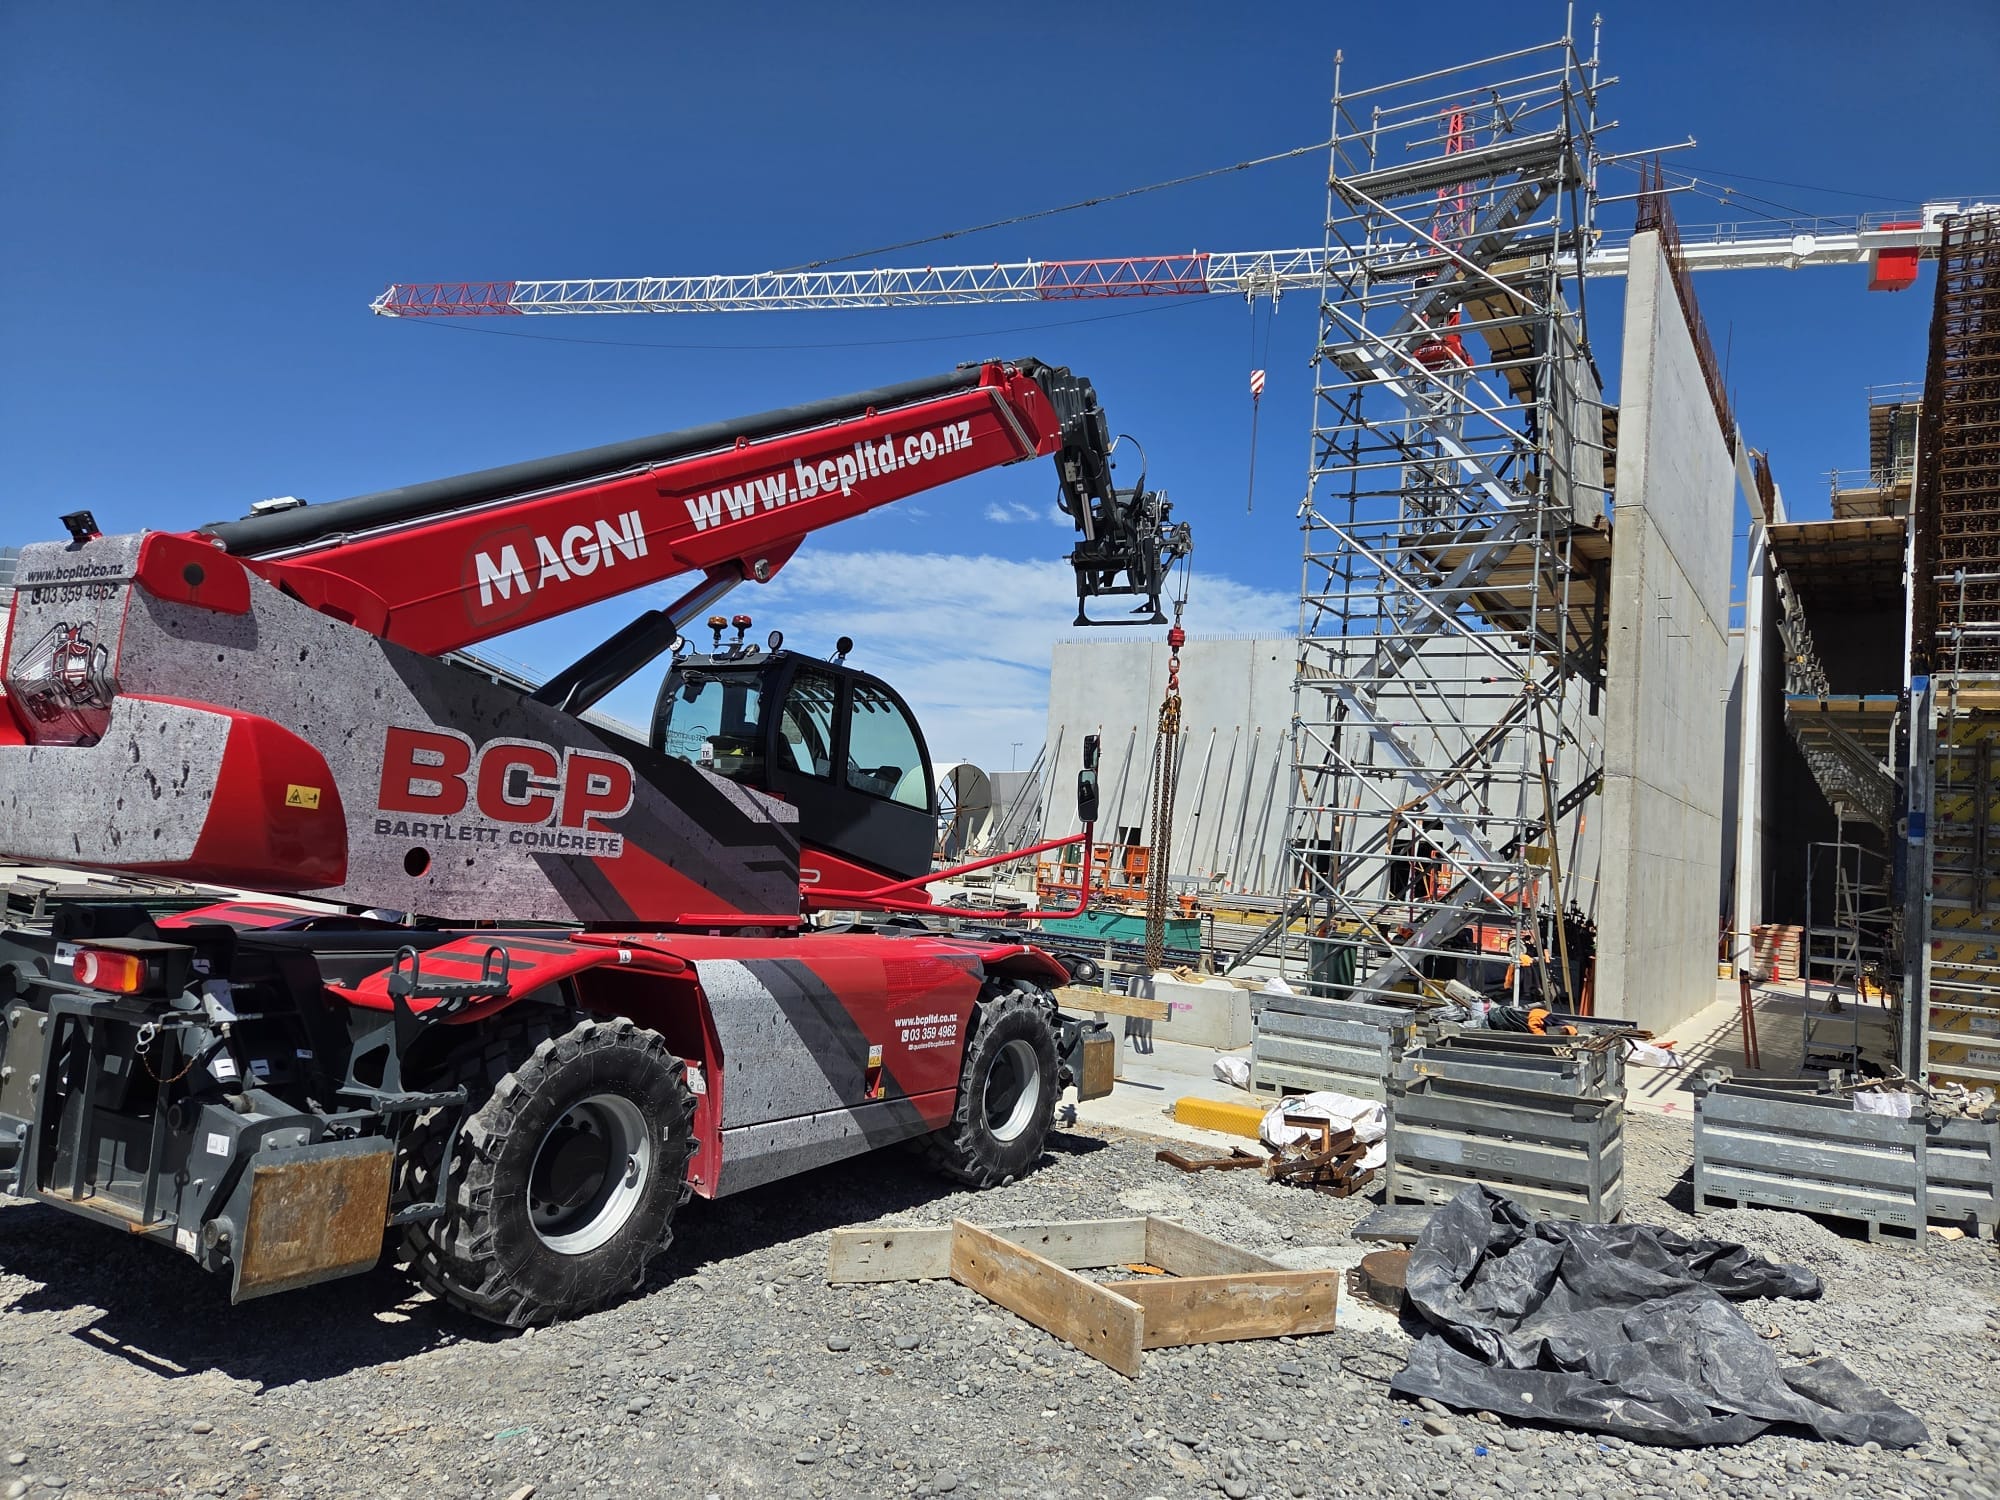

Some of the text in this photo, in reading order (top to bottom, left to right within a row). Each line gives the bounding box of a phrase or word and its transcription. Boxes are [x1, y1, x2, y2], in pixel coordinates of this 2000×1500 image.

[684, 420, 973, 531] www.bcpltd.co.nz
[475, 510, 648, 607] MAGNI
[27, 564, 123, 582] www.bcpltd.co.nz
[41, 581, 119, 604] 03 359 4962
[377, 725, 634, 830] BCP
[374, 819, 620, 853] BARTLETT CONCRETE
[895, 1013, 957, 1027] www.bcpltd.co.nz
[910, 1024, 957, 1041] 03 359 4962
